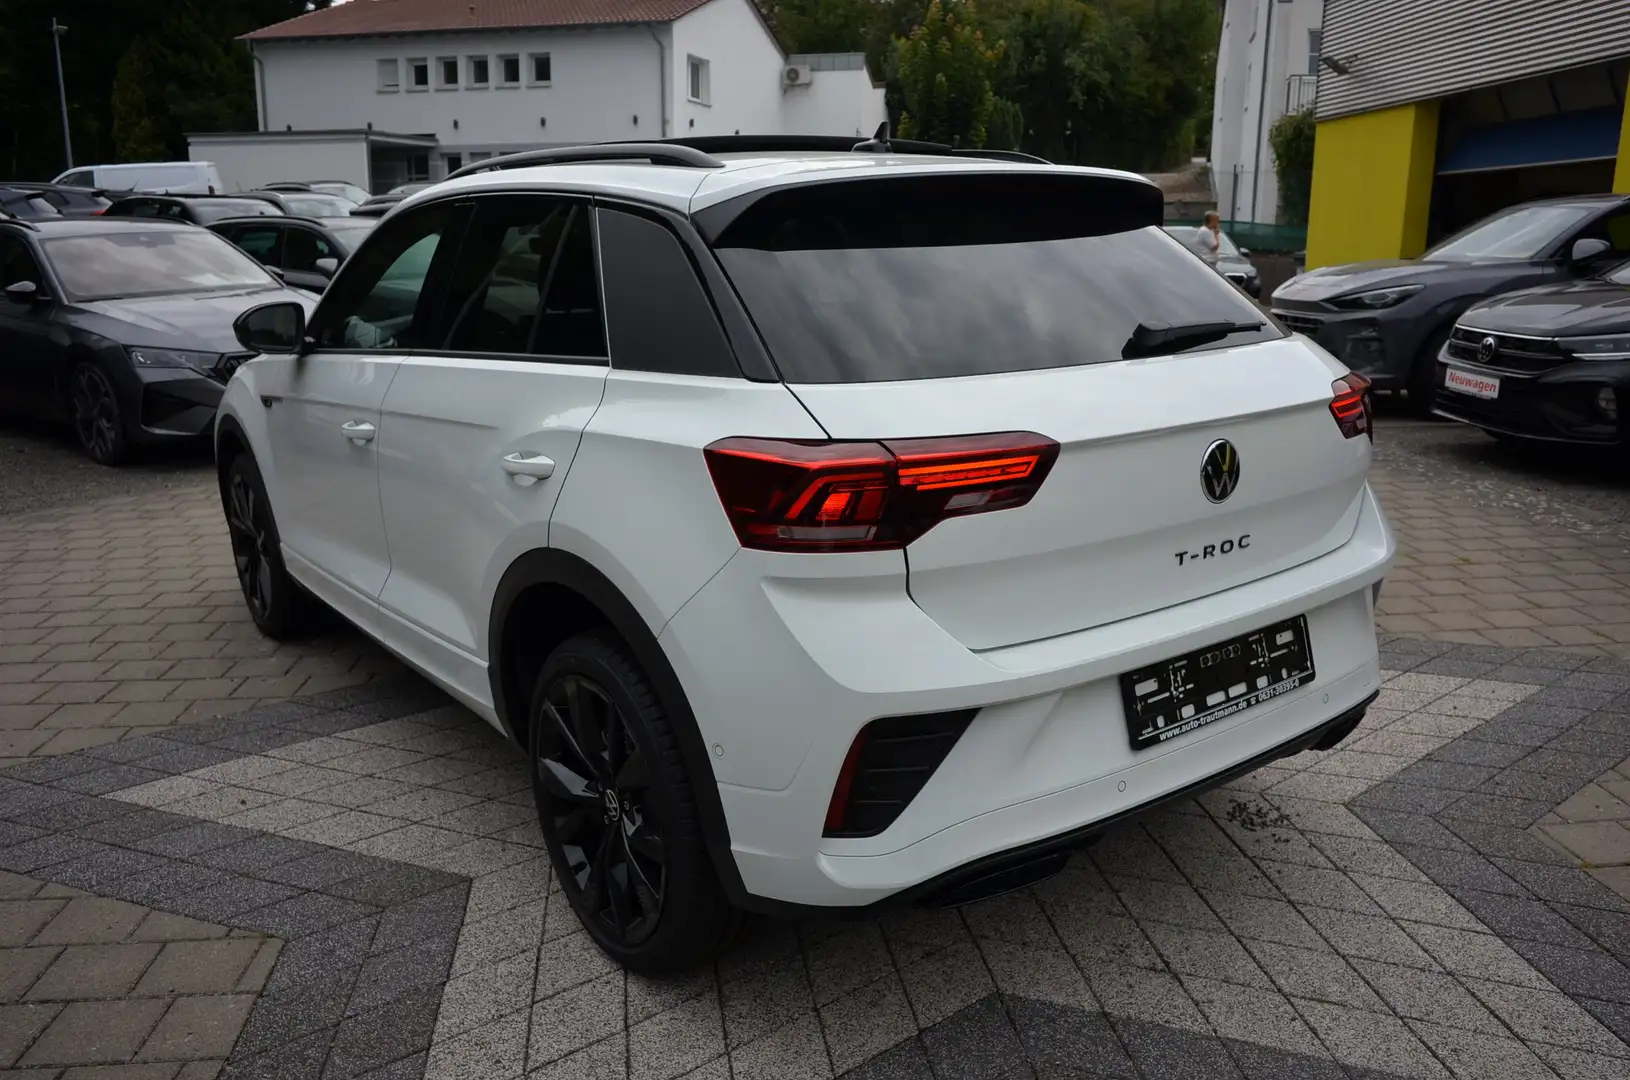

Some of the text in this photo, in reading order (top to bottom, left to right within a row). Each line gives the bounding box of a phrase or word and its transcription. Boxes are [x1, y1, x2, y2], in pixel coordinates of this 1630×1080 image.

[1448, 371, 1497, 393] Neuwagen
[1174, 534, 1251, 566] T-ROC
[1159, 699, 1248, 741] www.auto-trautmann.de
